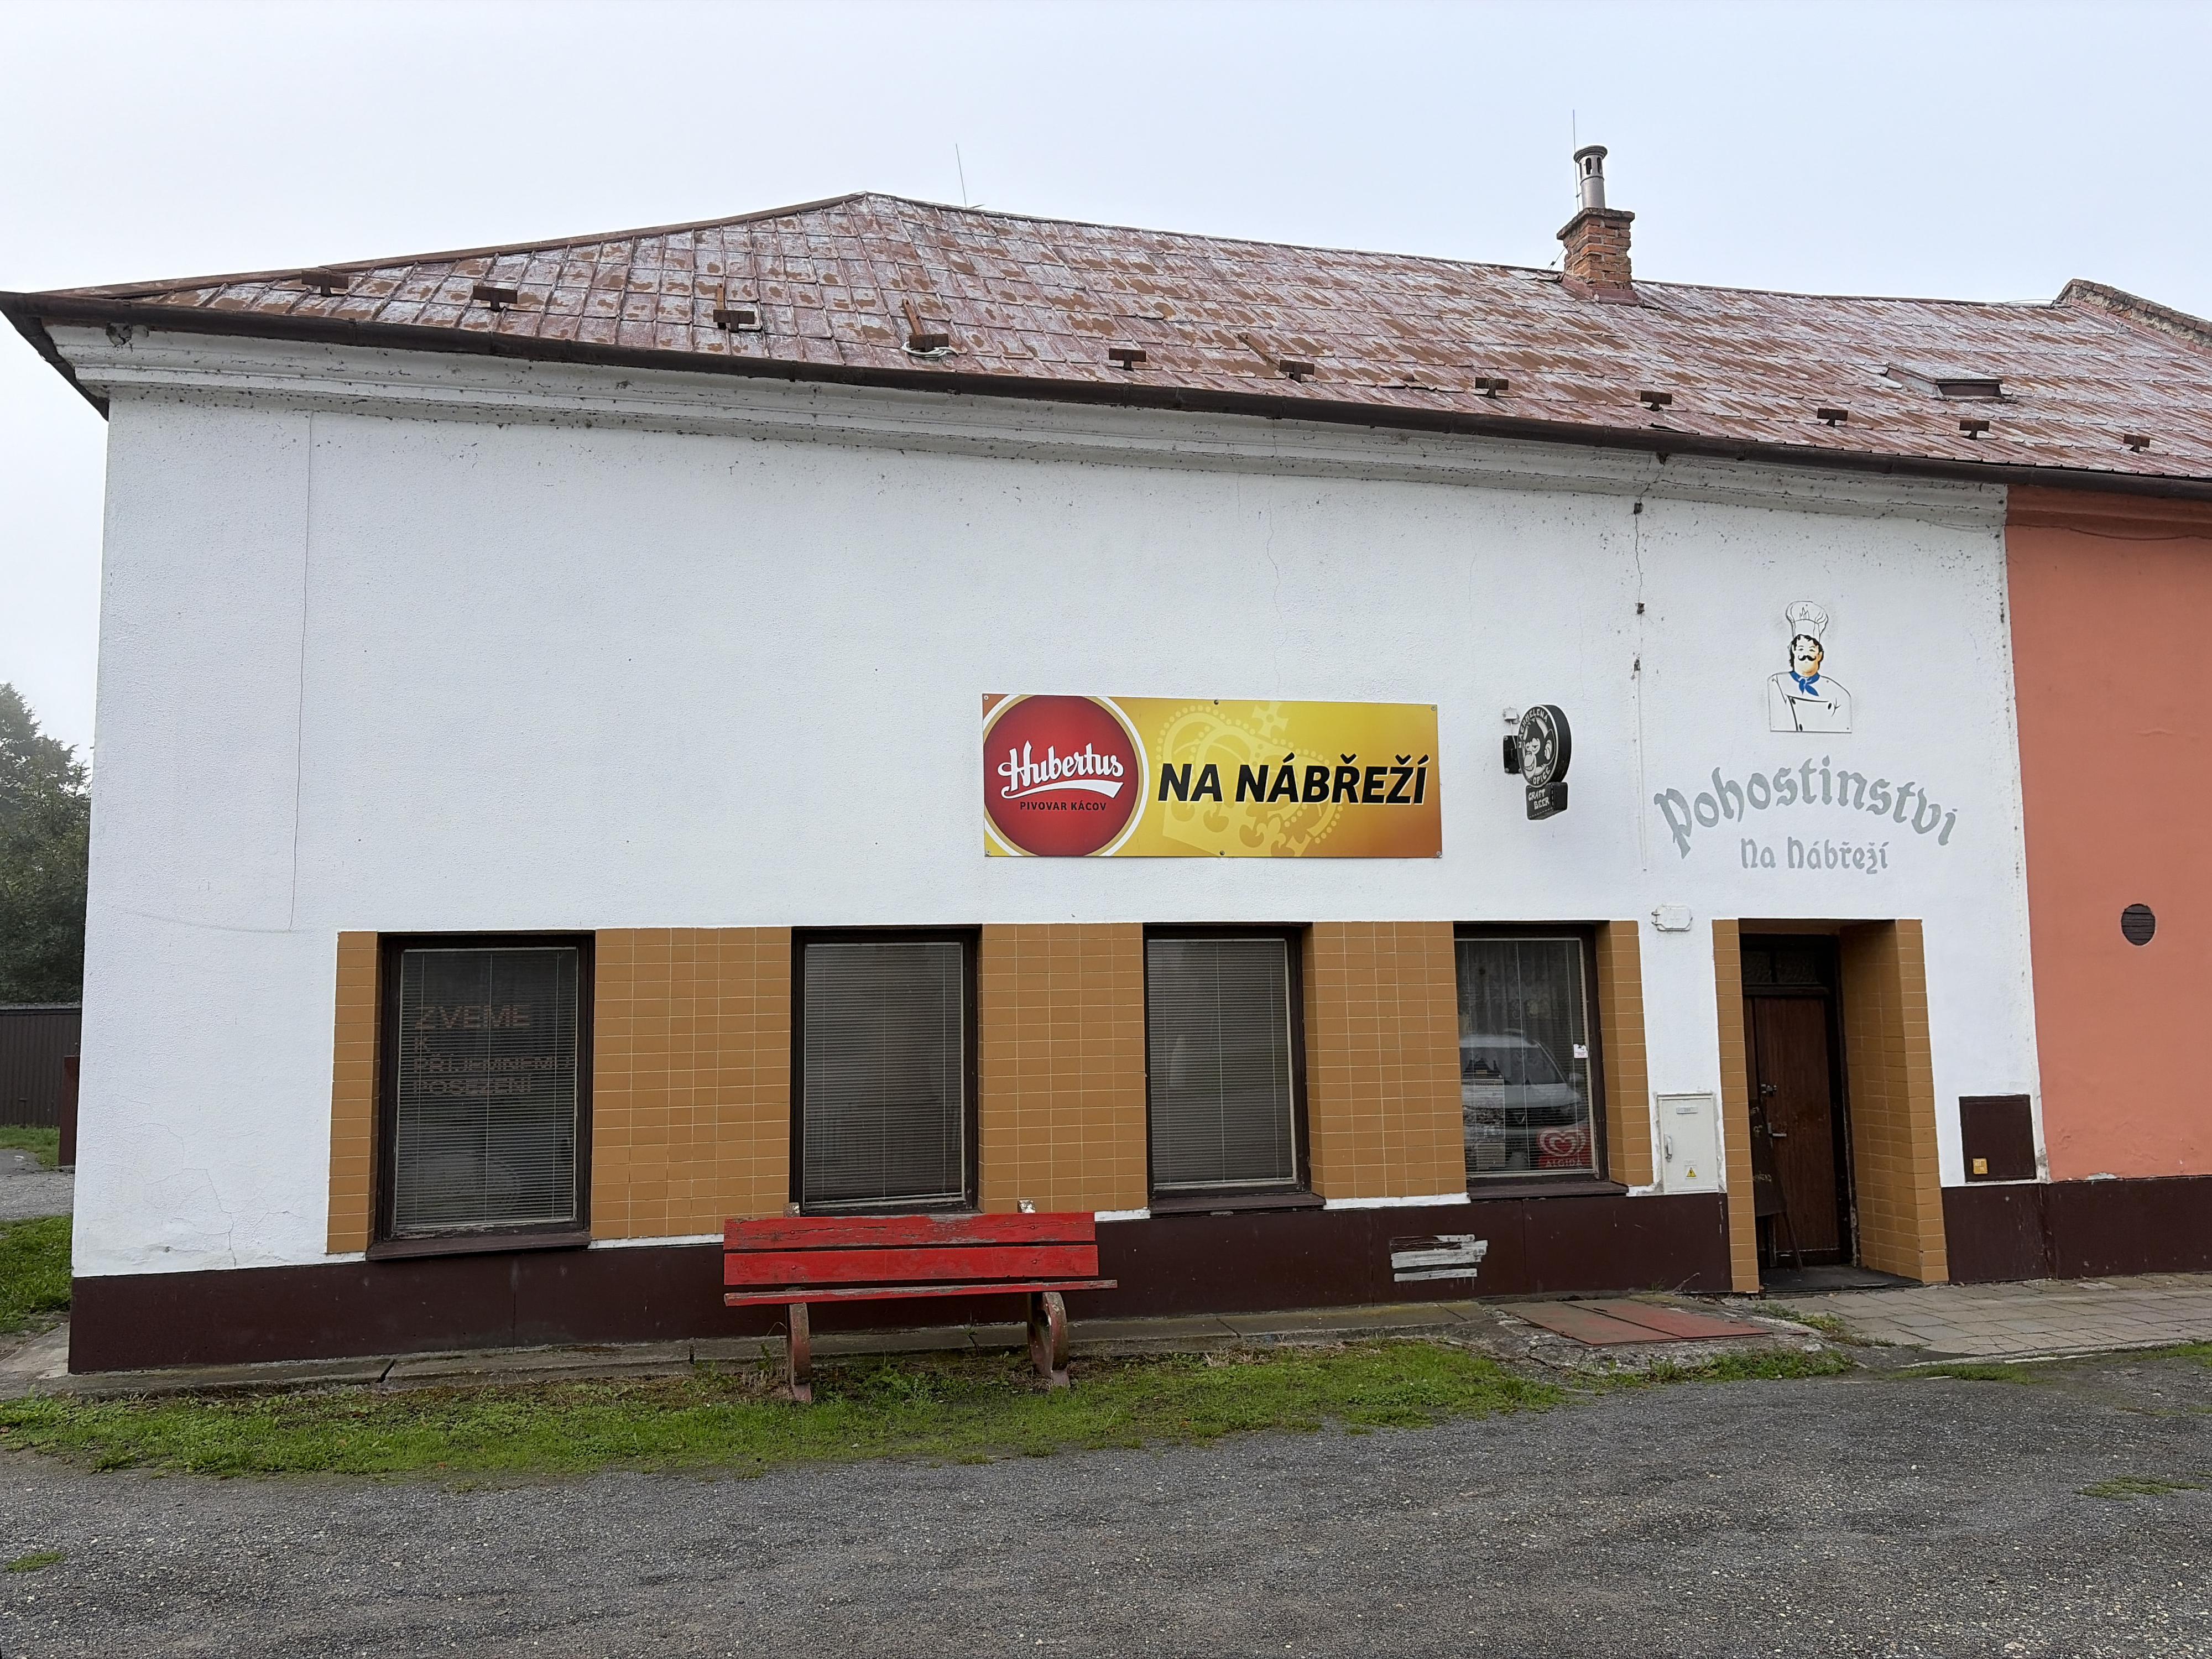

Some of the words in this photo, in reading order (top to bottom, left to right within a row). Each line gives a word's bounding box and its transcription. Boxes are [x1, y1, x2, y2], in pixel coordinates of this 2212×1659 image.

[998, 740, 1124, 791] Hubertus
[1533, 766, 1551, 785] OPICE
[1157, 763, 1223, 802] NA
[1235, 752, 1430, 805] NÁBŘEŽÍ
[1020, 801, 1067, 811] PIVOVAR
[1071, 800, 1107, 811] KÁCOV
[1528, 789, 1545, 801] CRAFT
[1534, 797, 1550, 810] BEER
[1741, 838, 1776, 868] Na
[1788, 836, 1889, 874] Nábřeží
[415, 1005, 530, 1029] ZVEME
